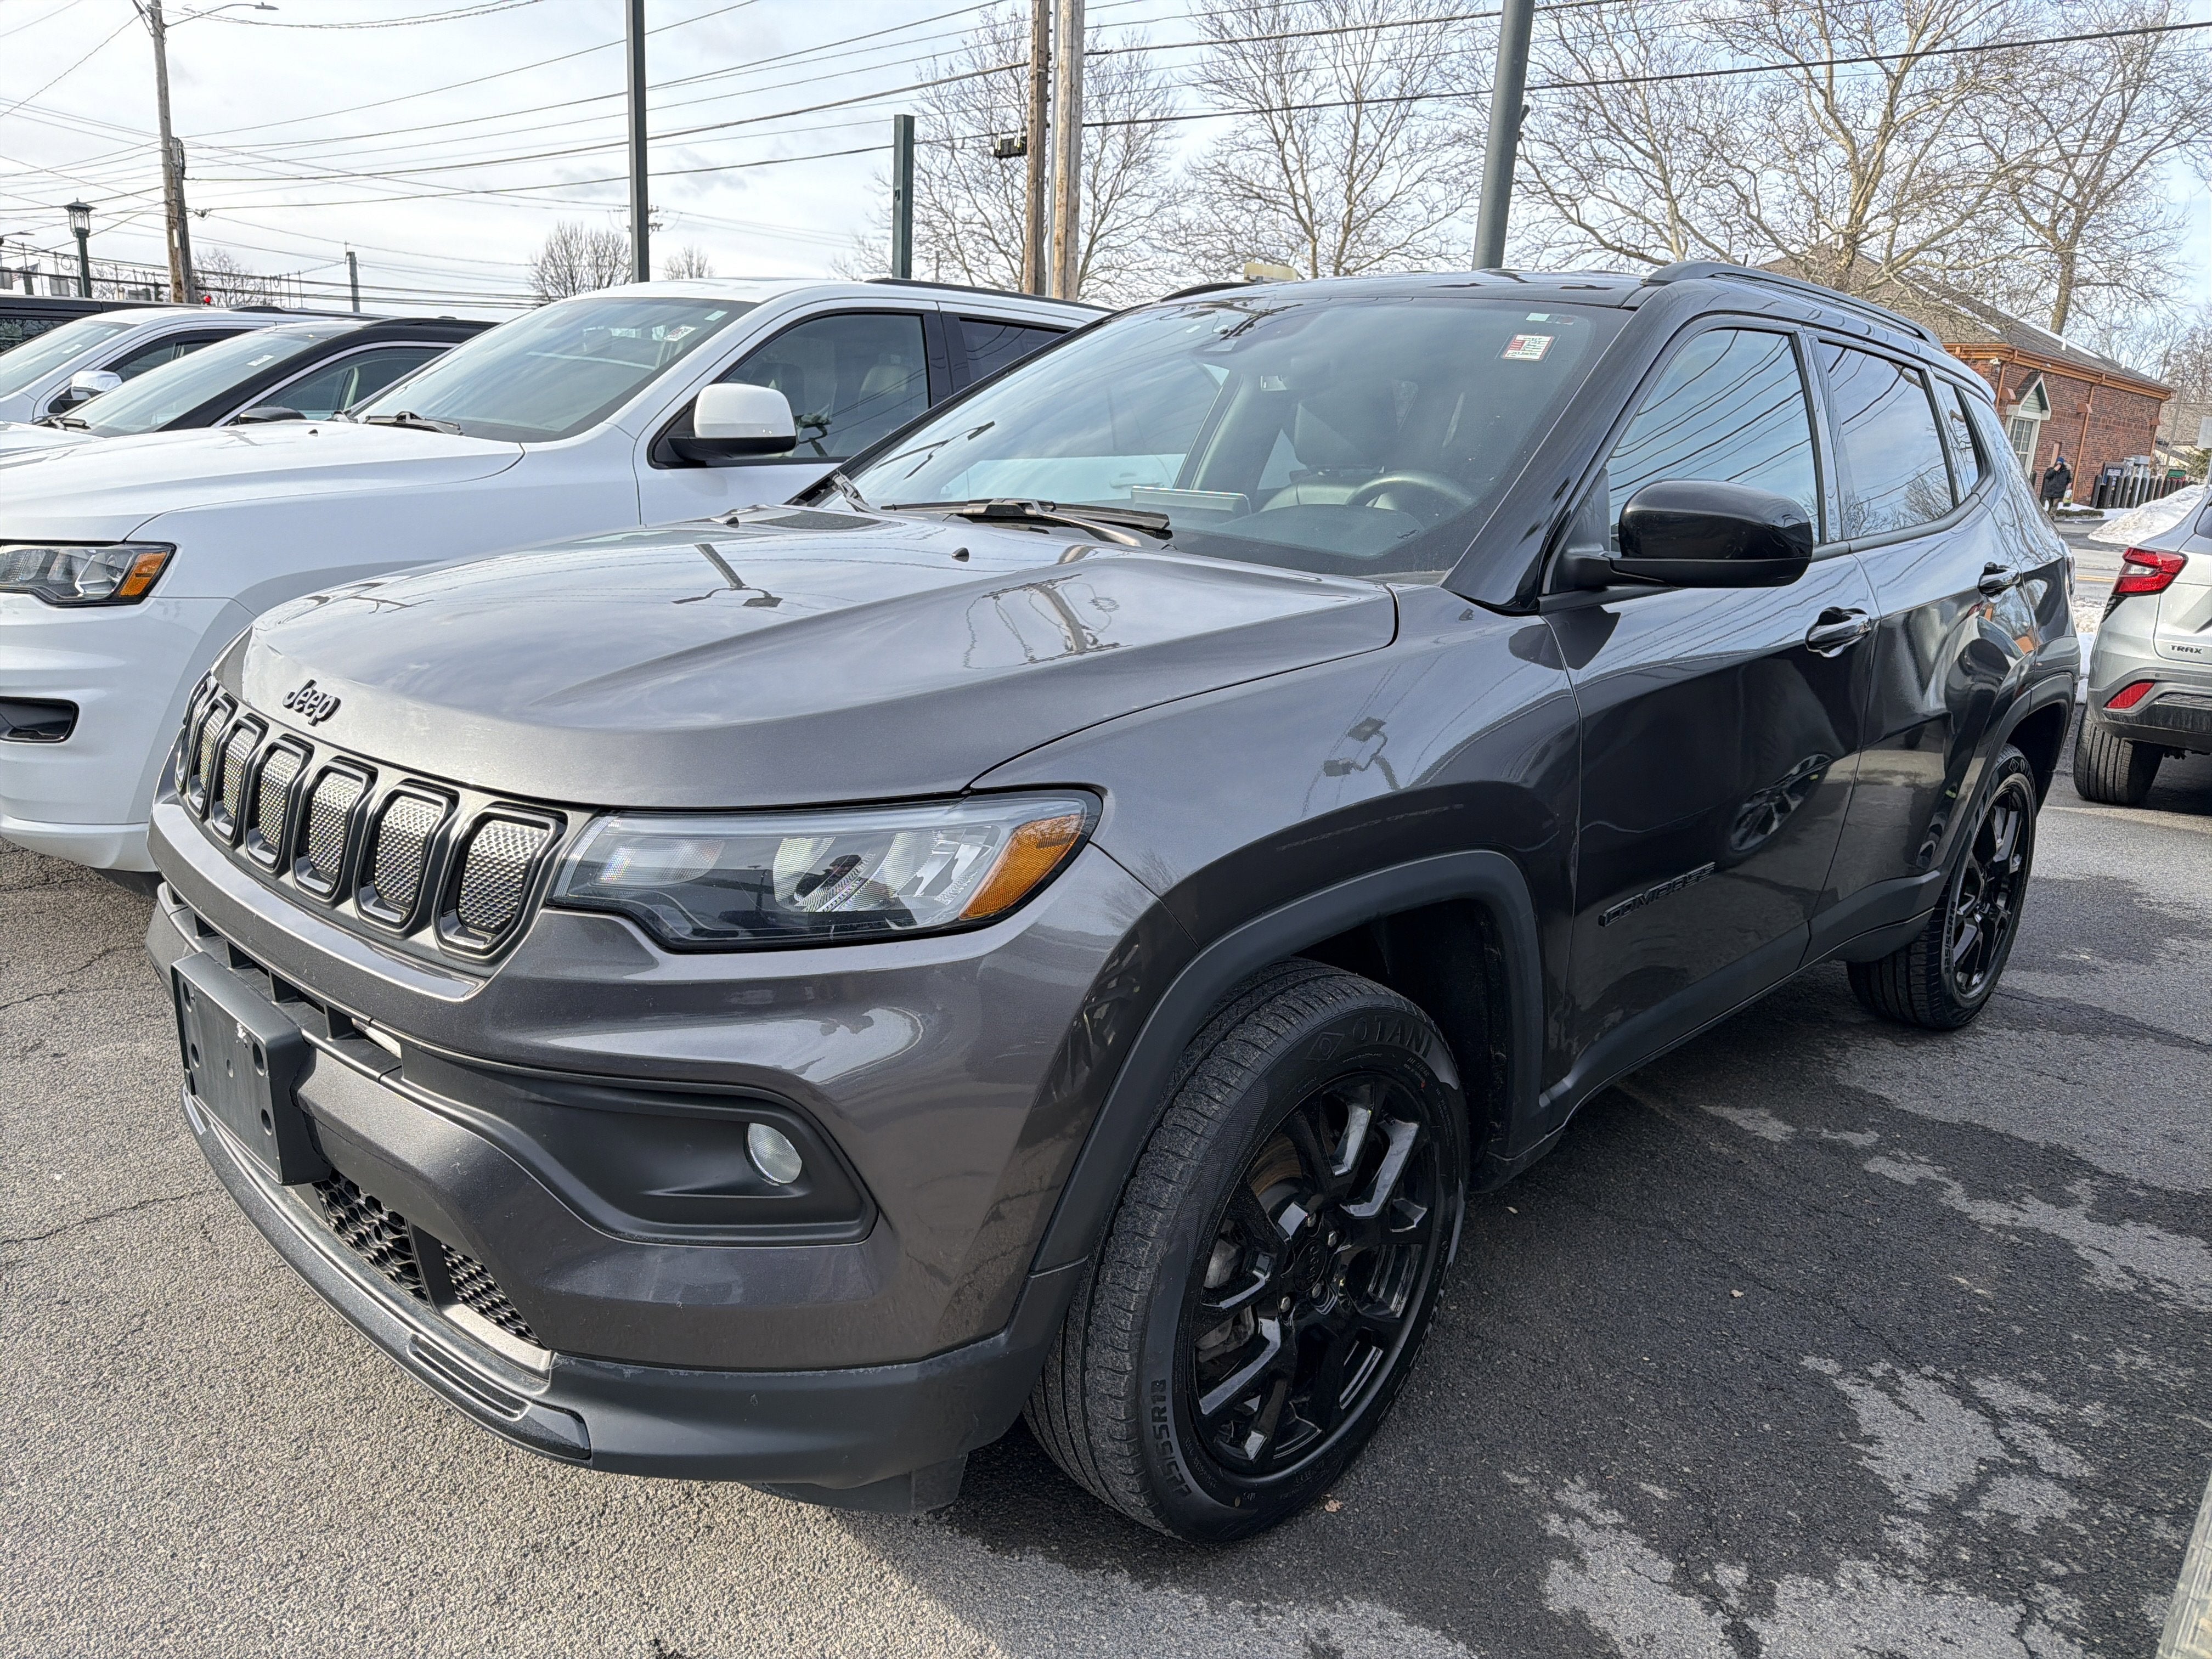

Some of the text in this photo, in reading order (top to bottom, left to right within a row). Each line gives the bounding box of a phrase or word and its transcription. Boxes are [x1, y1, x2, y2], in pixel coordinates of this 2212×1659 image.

[2171, 645, 2203, 654] TRAX
[283, 679, 342, 727] Jeep
[1598, 861, 1716, 927] COMPASS
[1352, 1015, 1433, 1058] OTANI
